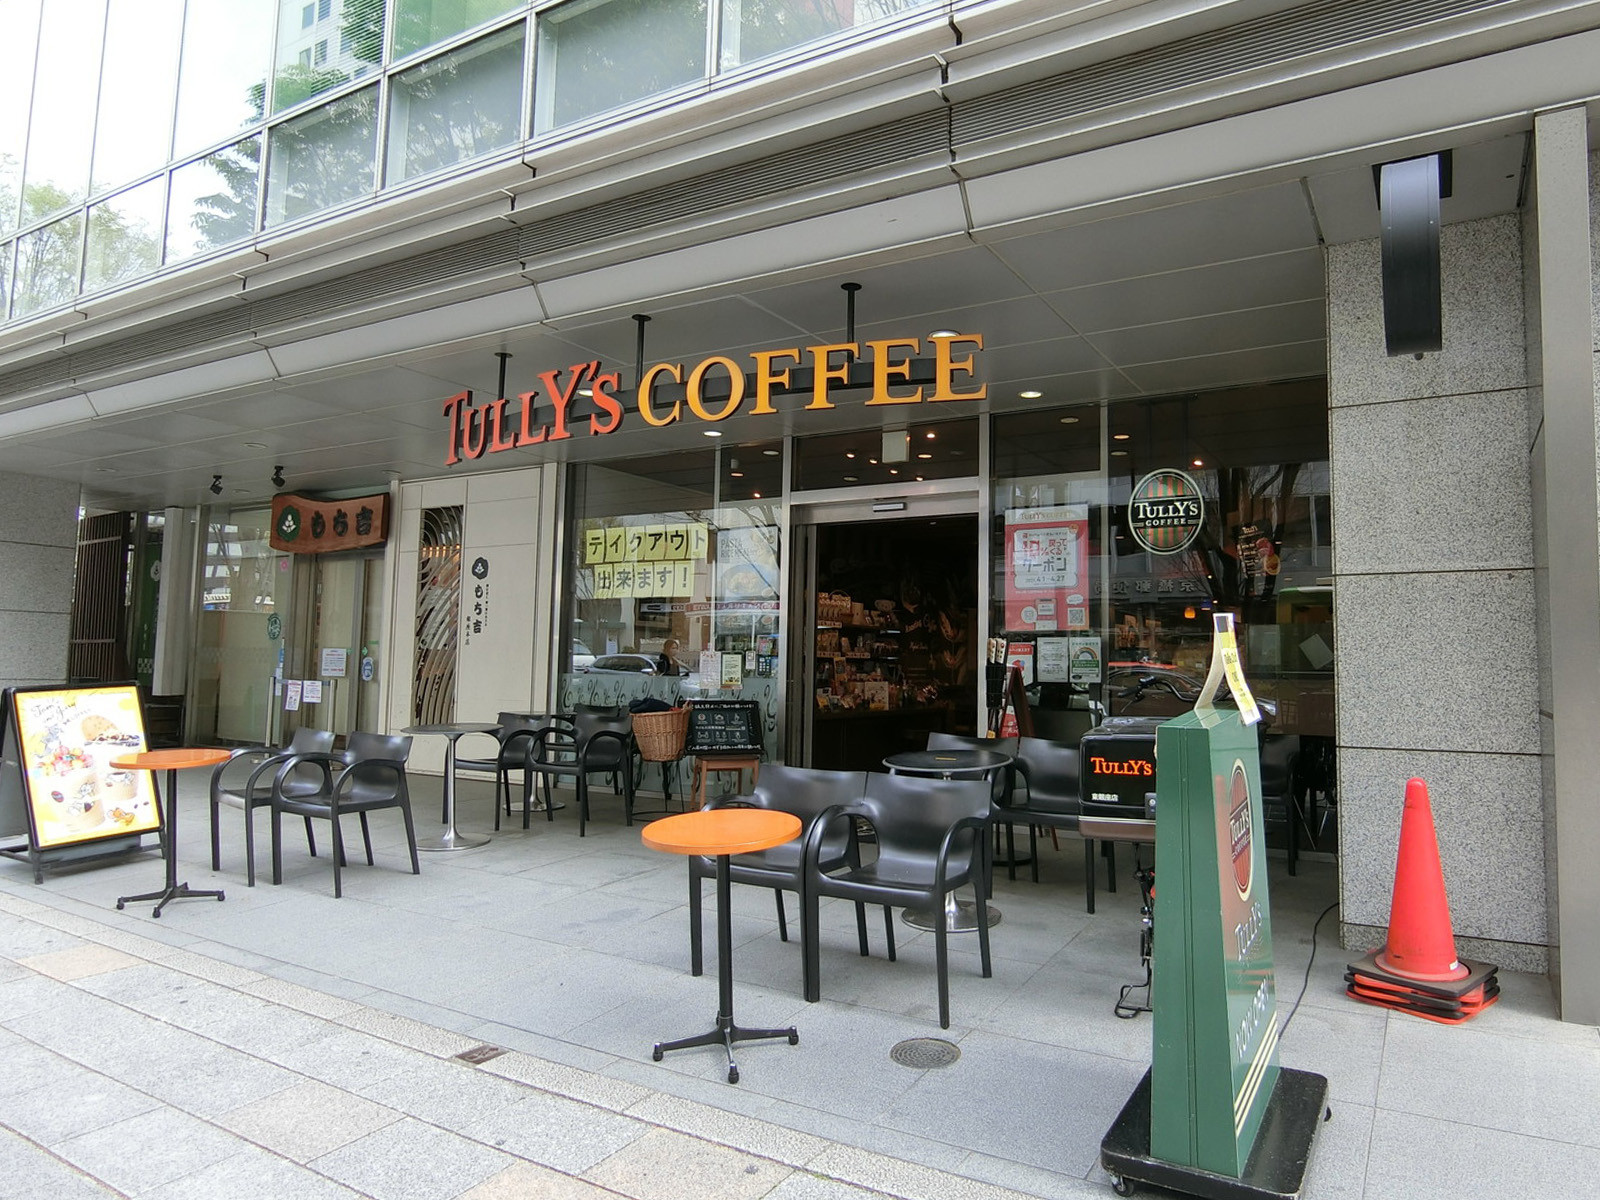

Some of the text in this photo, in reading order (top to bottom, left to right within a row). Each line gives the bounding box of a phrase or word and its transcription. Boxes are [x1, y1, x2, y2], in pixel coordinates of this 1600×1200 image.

[442, 334, 988, 466] TULLY'S COFFEE
[1134, 501, 1199, 519] TULLY'S
[311, 505, 374, 539] もち吉
[1145, 518, 1187, 527] COFFEE
[589, 529, 705, 555] テイクアウト
[1022, 556, 1067, 573] クーポン
[473, 584, 484, 634] もち吉
[1090, 757, 1152, 776] TULLY'S
